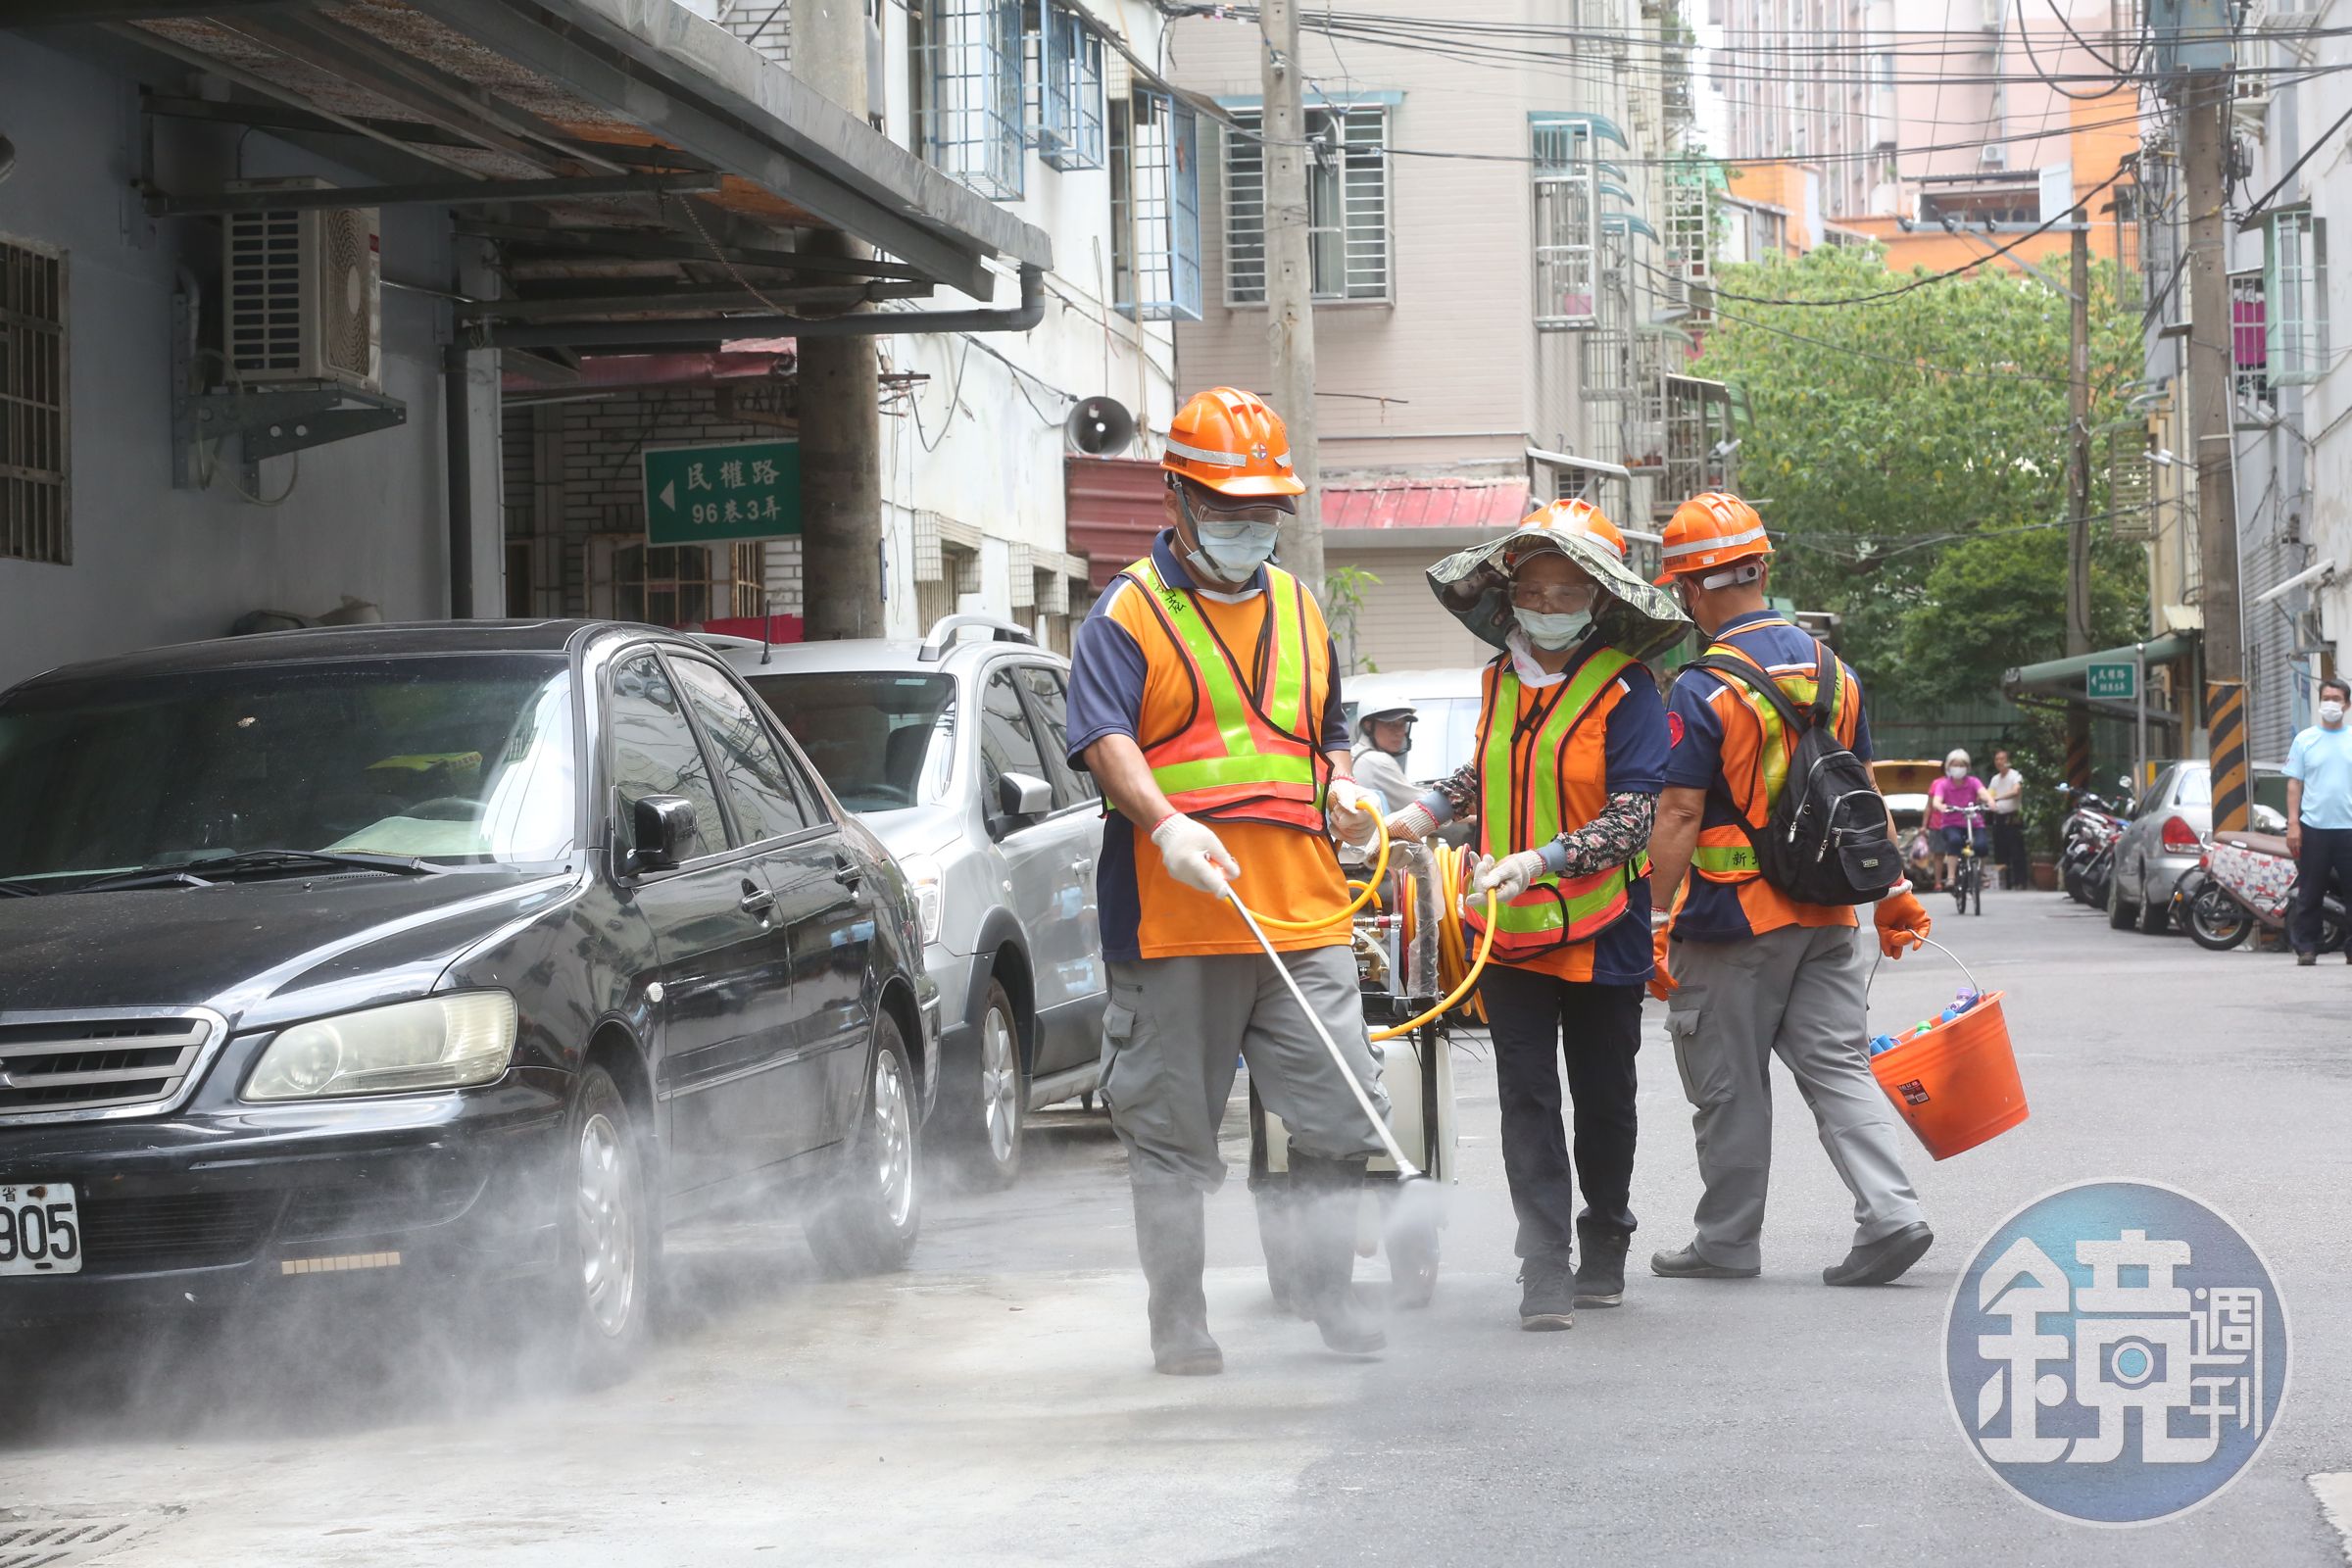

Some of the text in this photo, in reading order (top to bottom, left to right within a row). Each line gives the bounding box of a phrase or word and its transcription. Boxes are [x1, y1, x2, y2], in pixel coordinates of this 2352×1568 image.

[688, 459, 780, 490] 民權路
[692, 495, 781, 524] 96巷3弄
